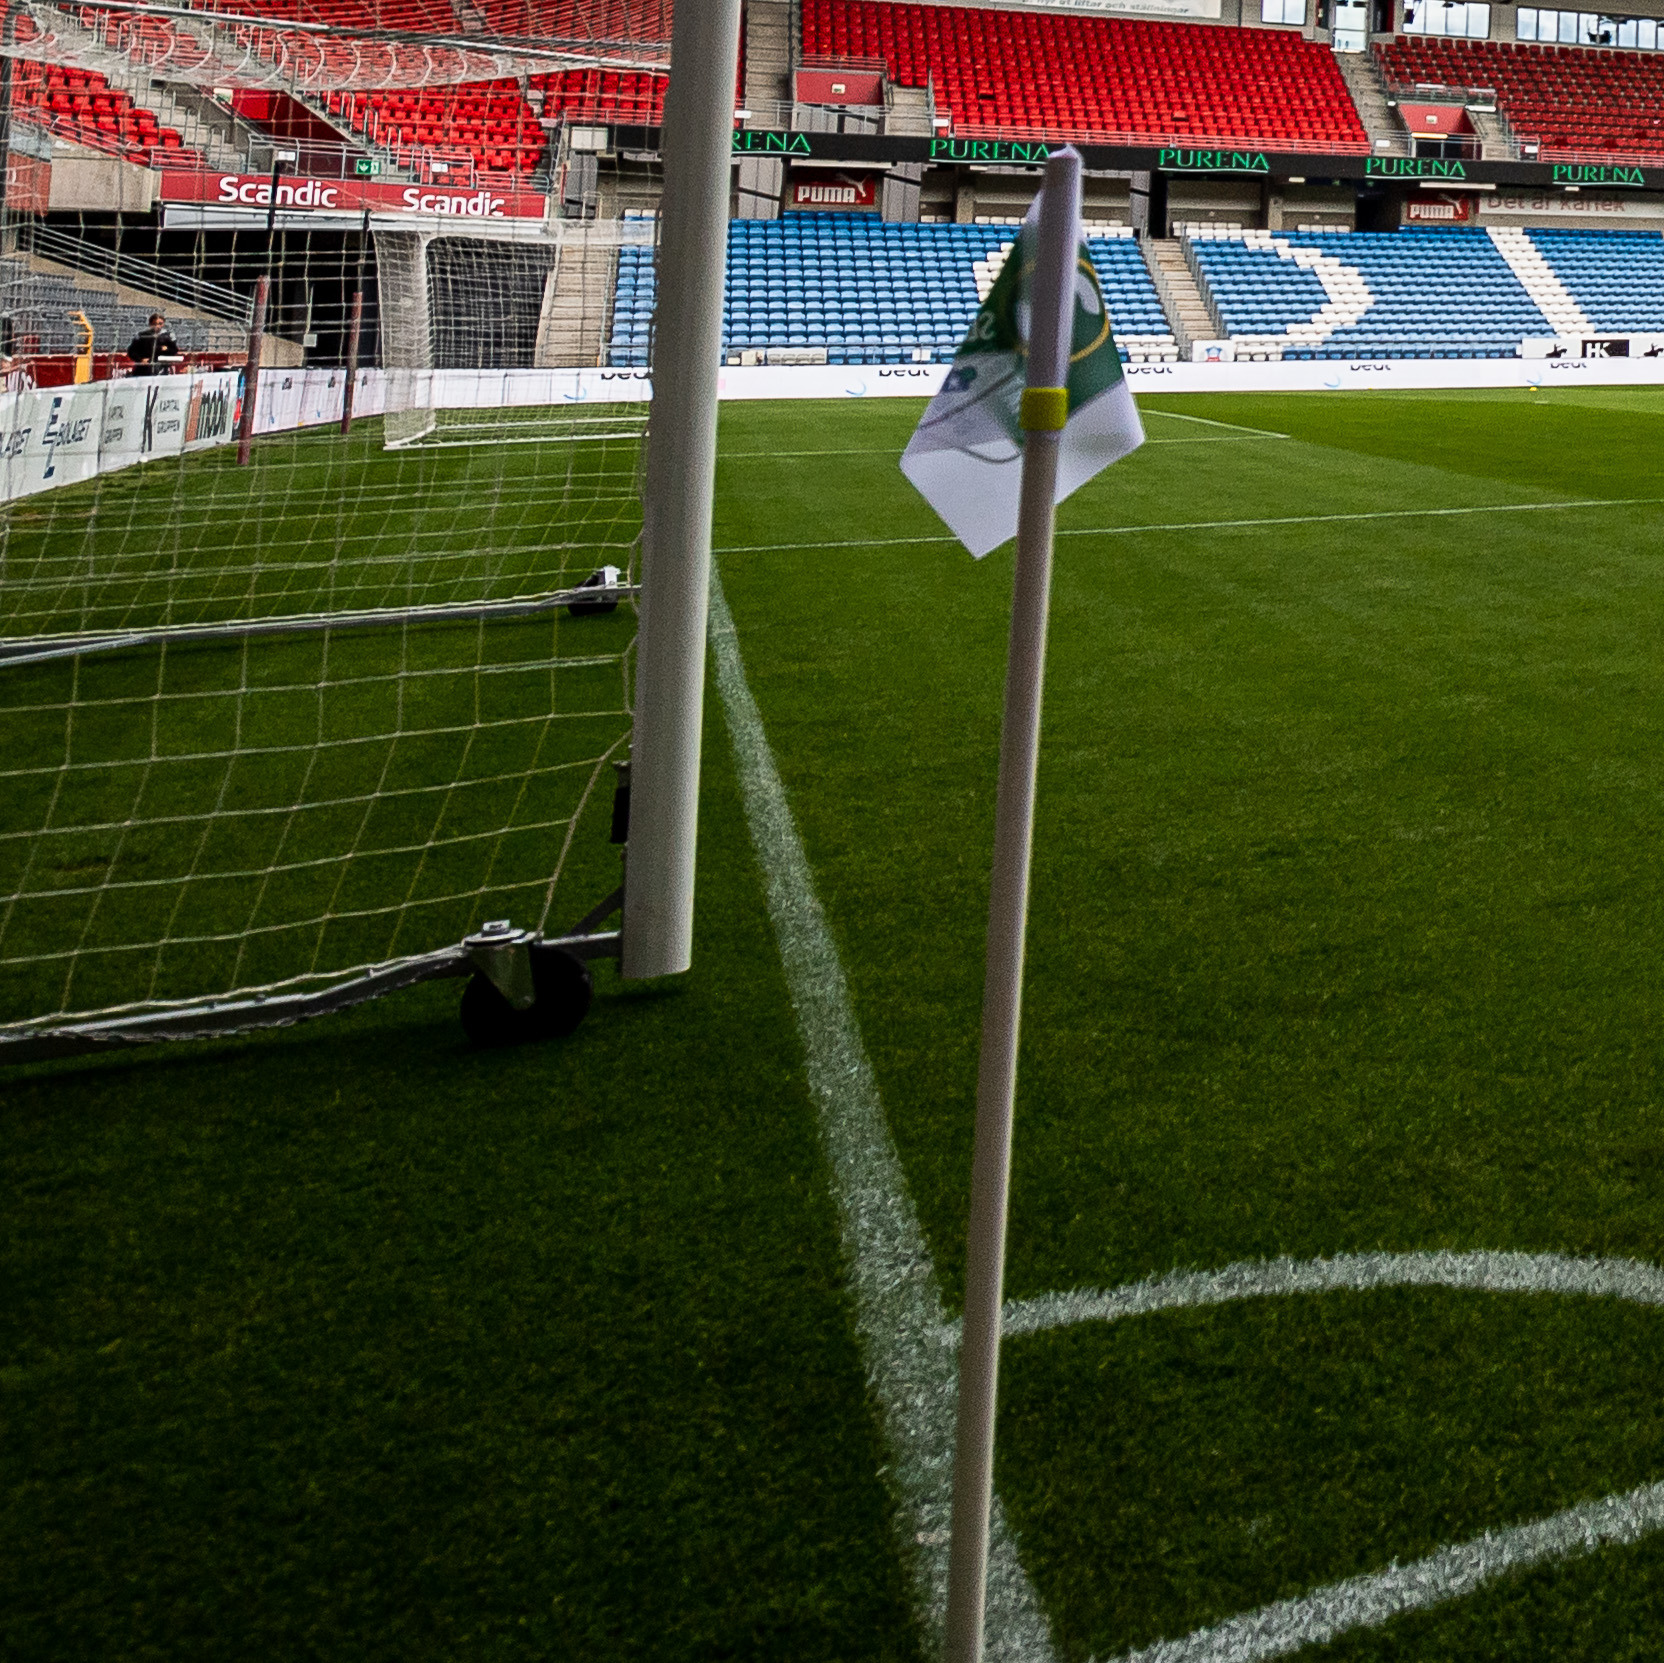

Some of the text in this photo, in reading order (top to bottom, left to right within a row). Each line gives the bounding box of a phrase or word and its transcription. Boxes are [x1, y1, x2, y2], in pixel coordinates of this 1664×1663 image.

[732, 132, 811, 151] RENA
[930, 140, 1048, 159] PURENA
[1159, 150, 1269, 166] PURENA
[1366, 158, 1465, 172] PURENA
[1553, 166, 1644, 181] PURENA
[218, 176, 338, 209] Scandic
[797, 186, 856, 203] PUMA
[402, 189, 505, 218] Scandic
[1586, 341, 1611, 357] HK
